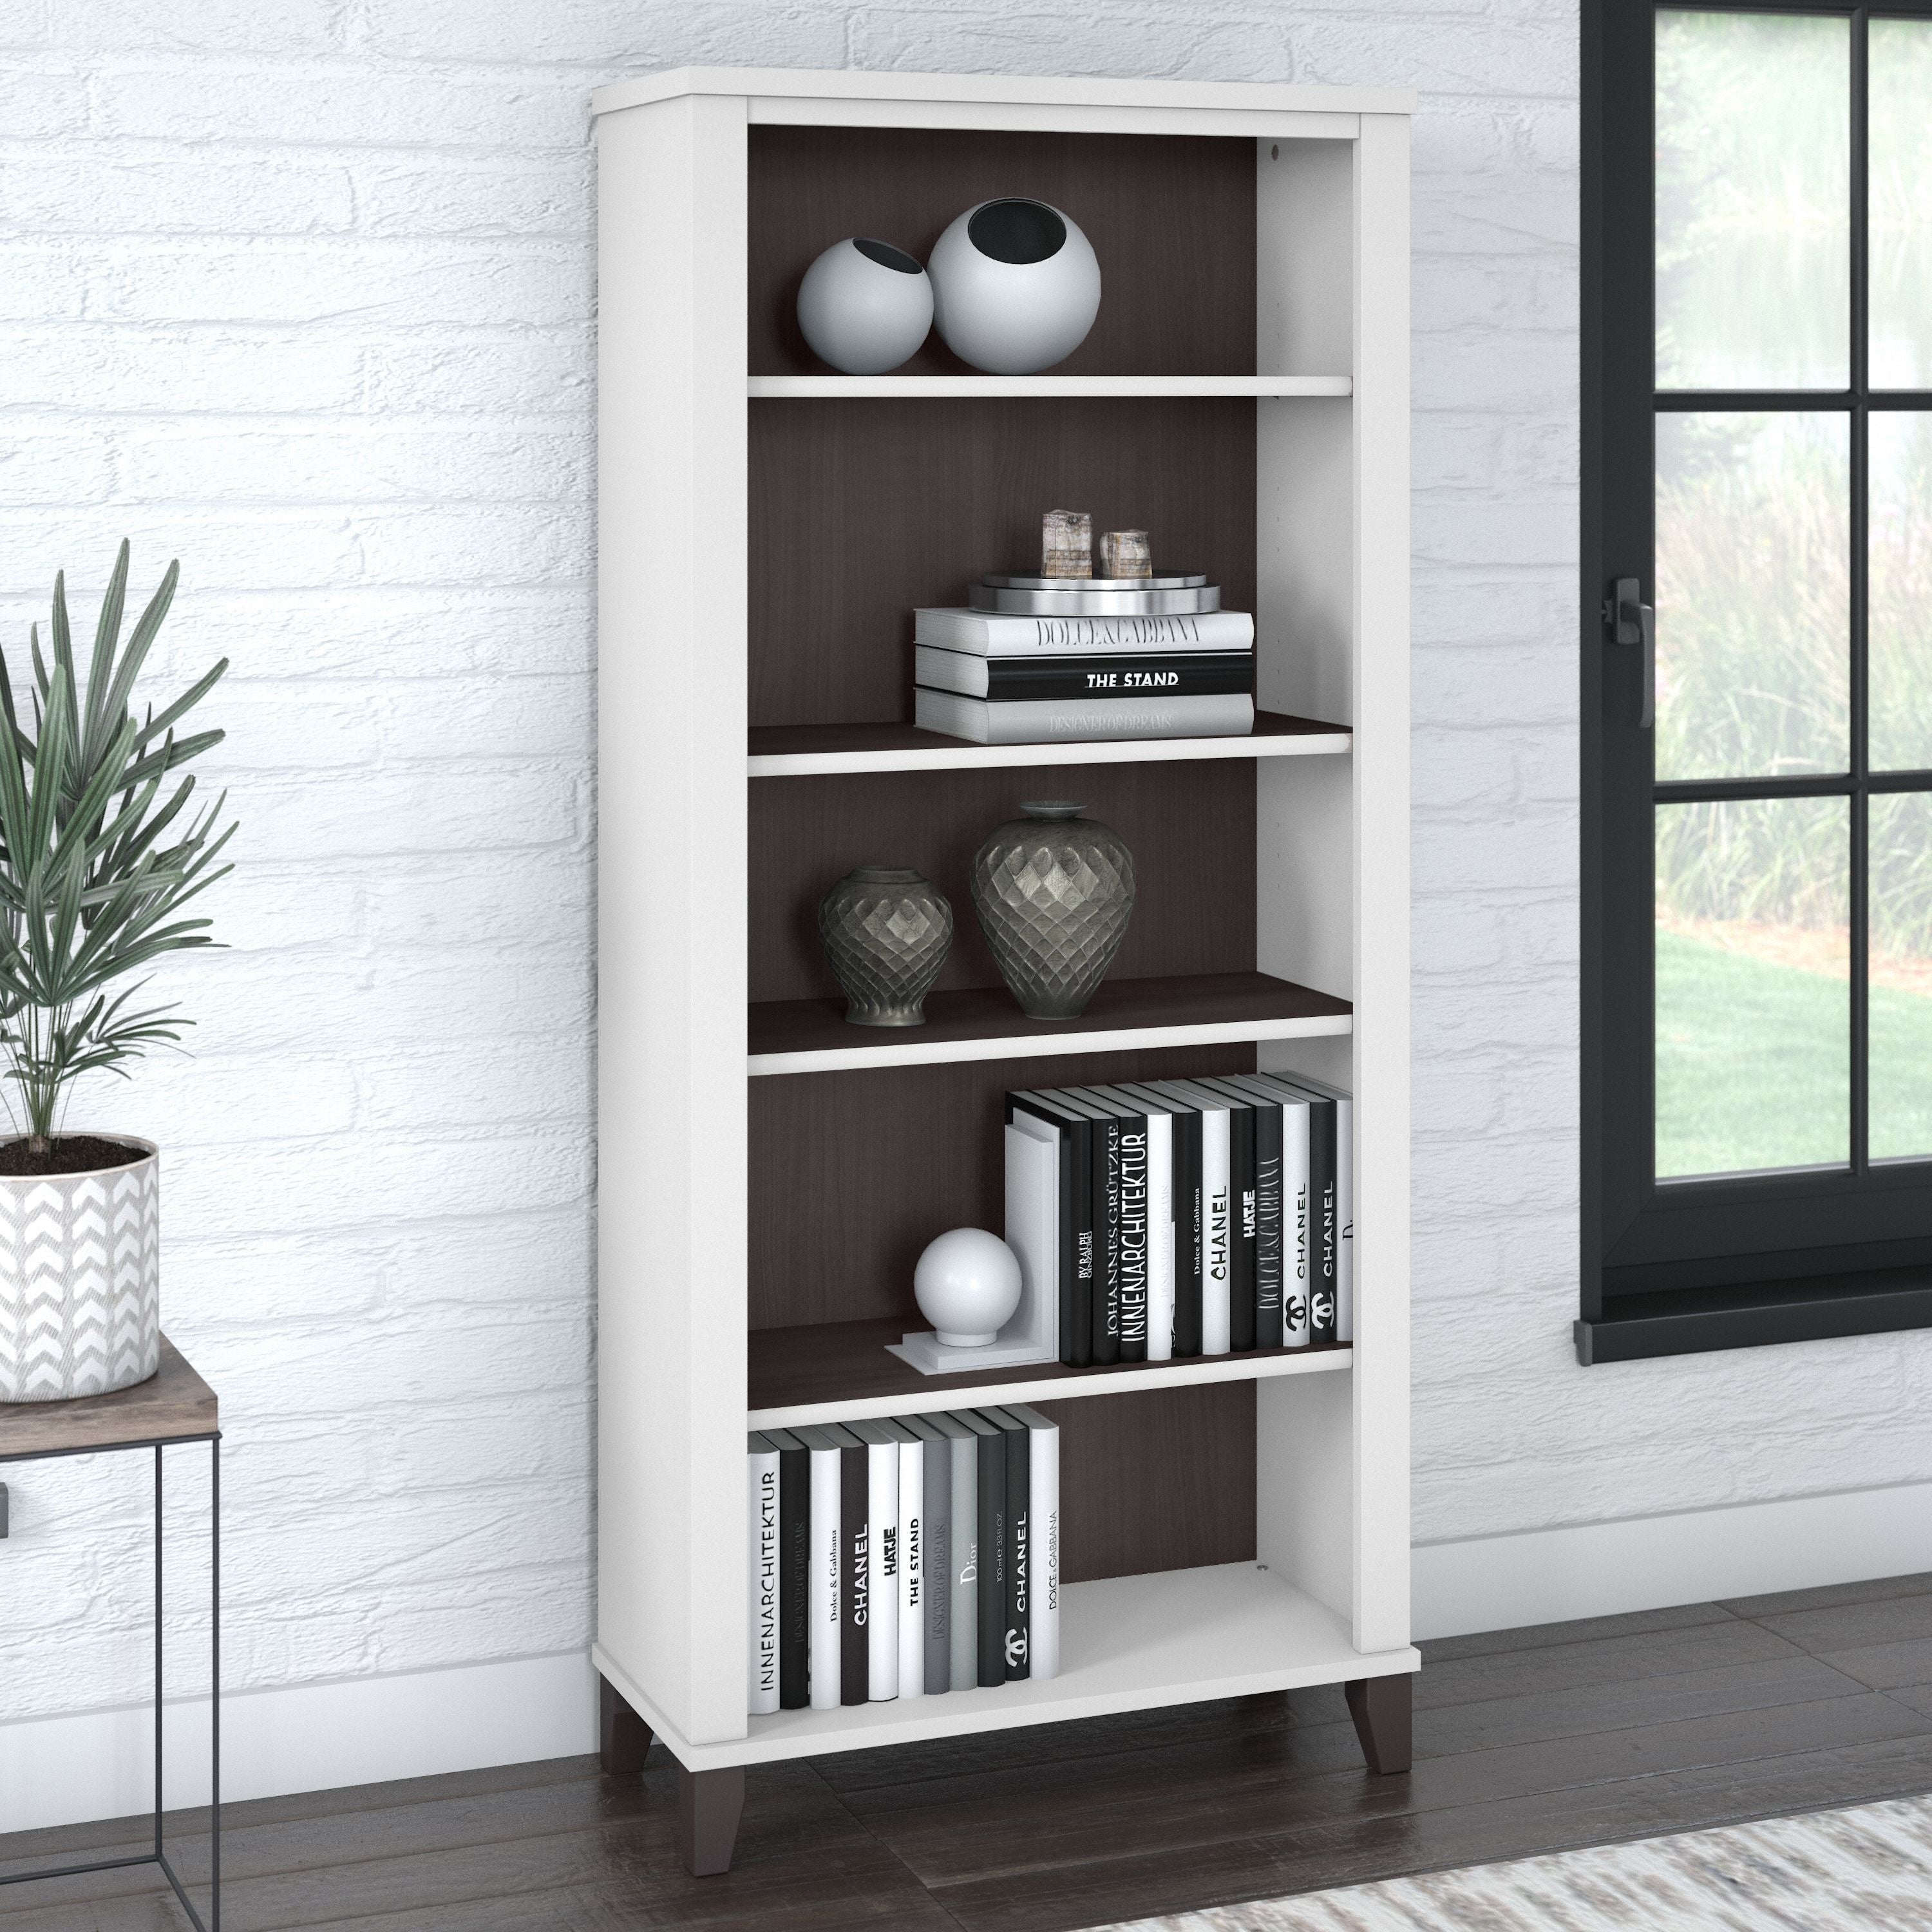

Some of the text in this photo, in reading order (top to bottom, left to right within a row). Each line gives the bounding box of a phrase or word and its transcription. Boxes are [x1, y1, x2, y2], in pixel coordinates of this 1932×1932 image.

[1087, 672, 1179, 688] THE STAND
[1078, 1232, 1088, 1279] BY RALPH
[1106, 1124, 1119, 1337] JOHANNES GRÜTZKE
[1121, 1133, 1146, 1341] INNENARCHITEKTUR
[1193, 1235, 1200, 1244] &
[1210, 1186, 1227, 1281] CHANEL
[1243, 1189, 1256, 1238] HATJE
[1297, 1183, 1305, 1280] CHANEL
[1323, 1180, 1333, 1278] CHANEL
[761, 1472, 775, 1691] INNENARCHITEKTUR
[854, 1523, 867, 1626] CHANEL
[884, 1526, 896, 1577] HATJE
[910, 1519, 918, 1607] THE STAND
[960, 1542, 977, 1585] Dior
[1017, 1511, 1027, 1613] CHANEL
[1048, 1510, 1057, 1567] GABBANA
[829, 1580, 837, 1589] &
